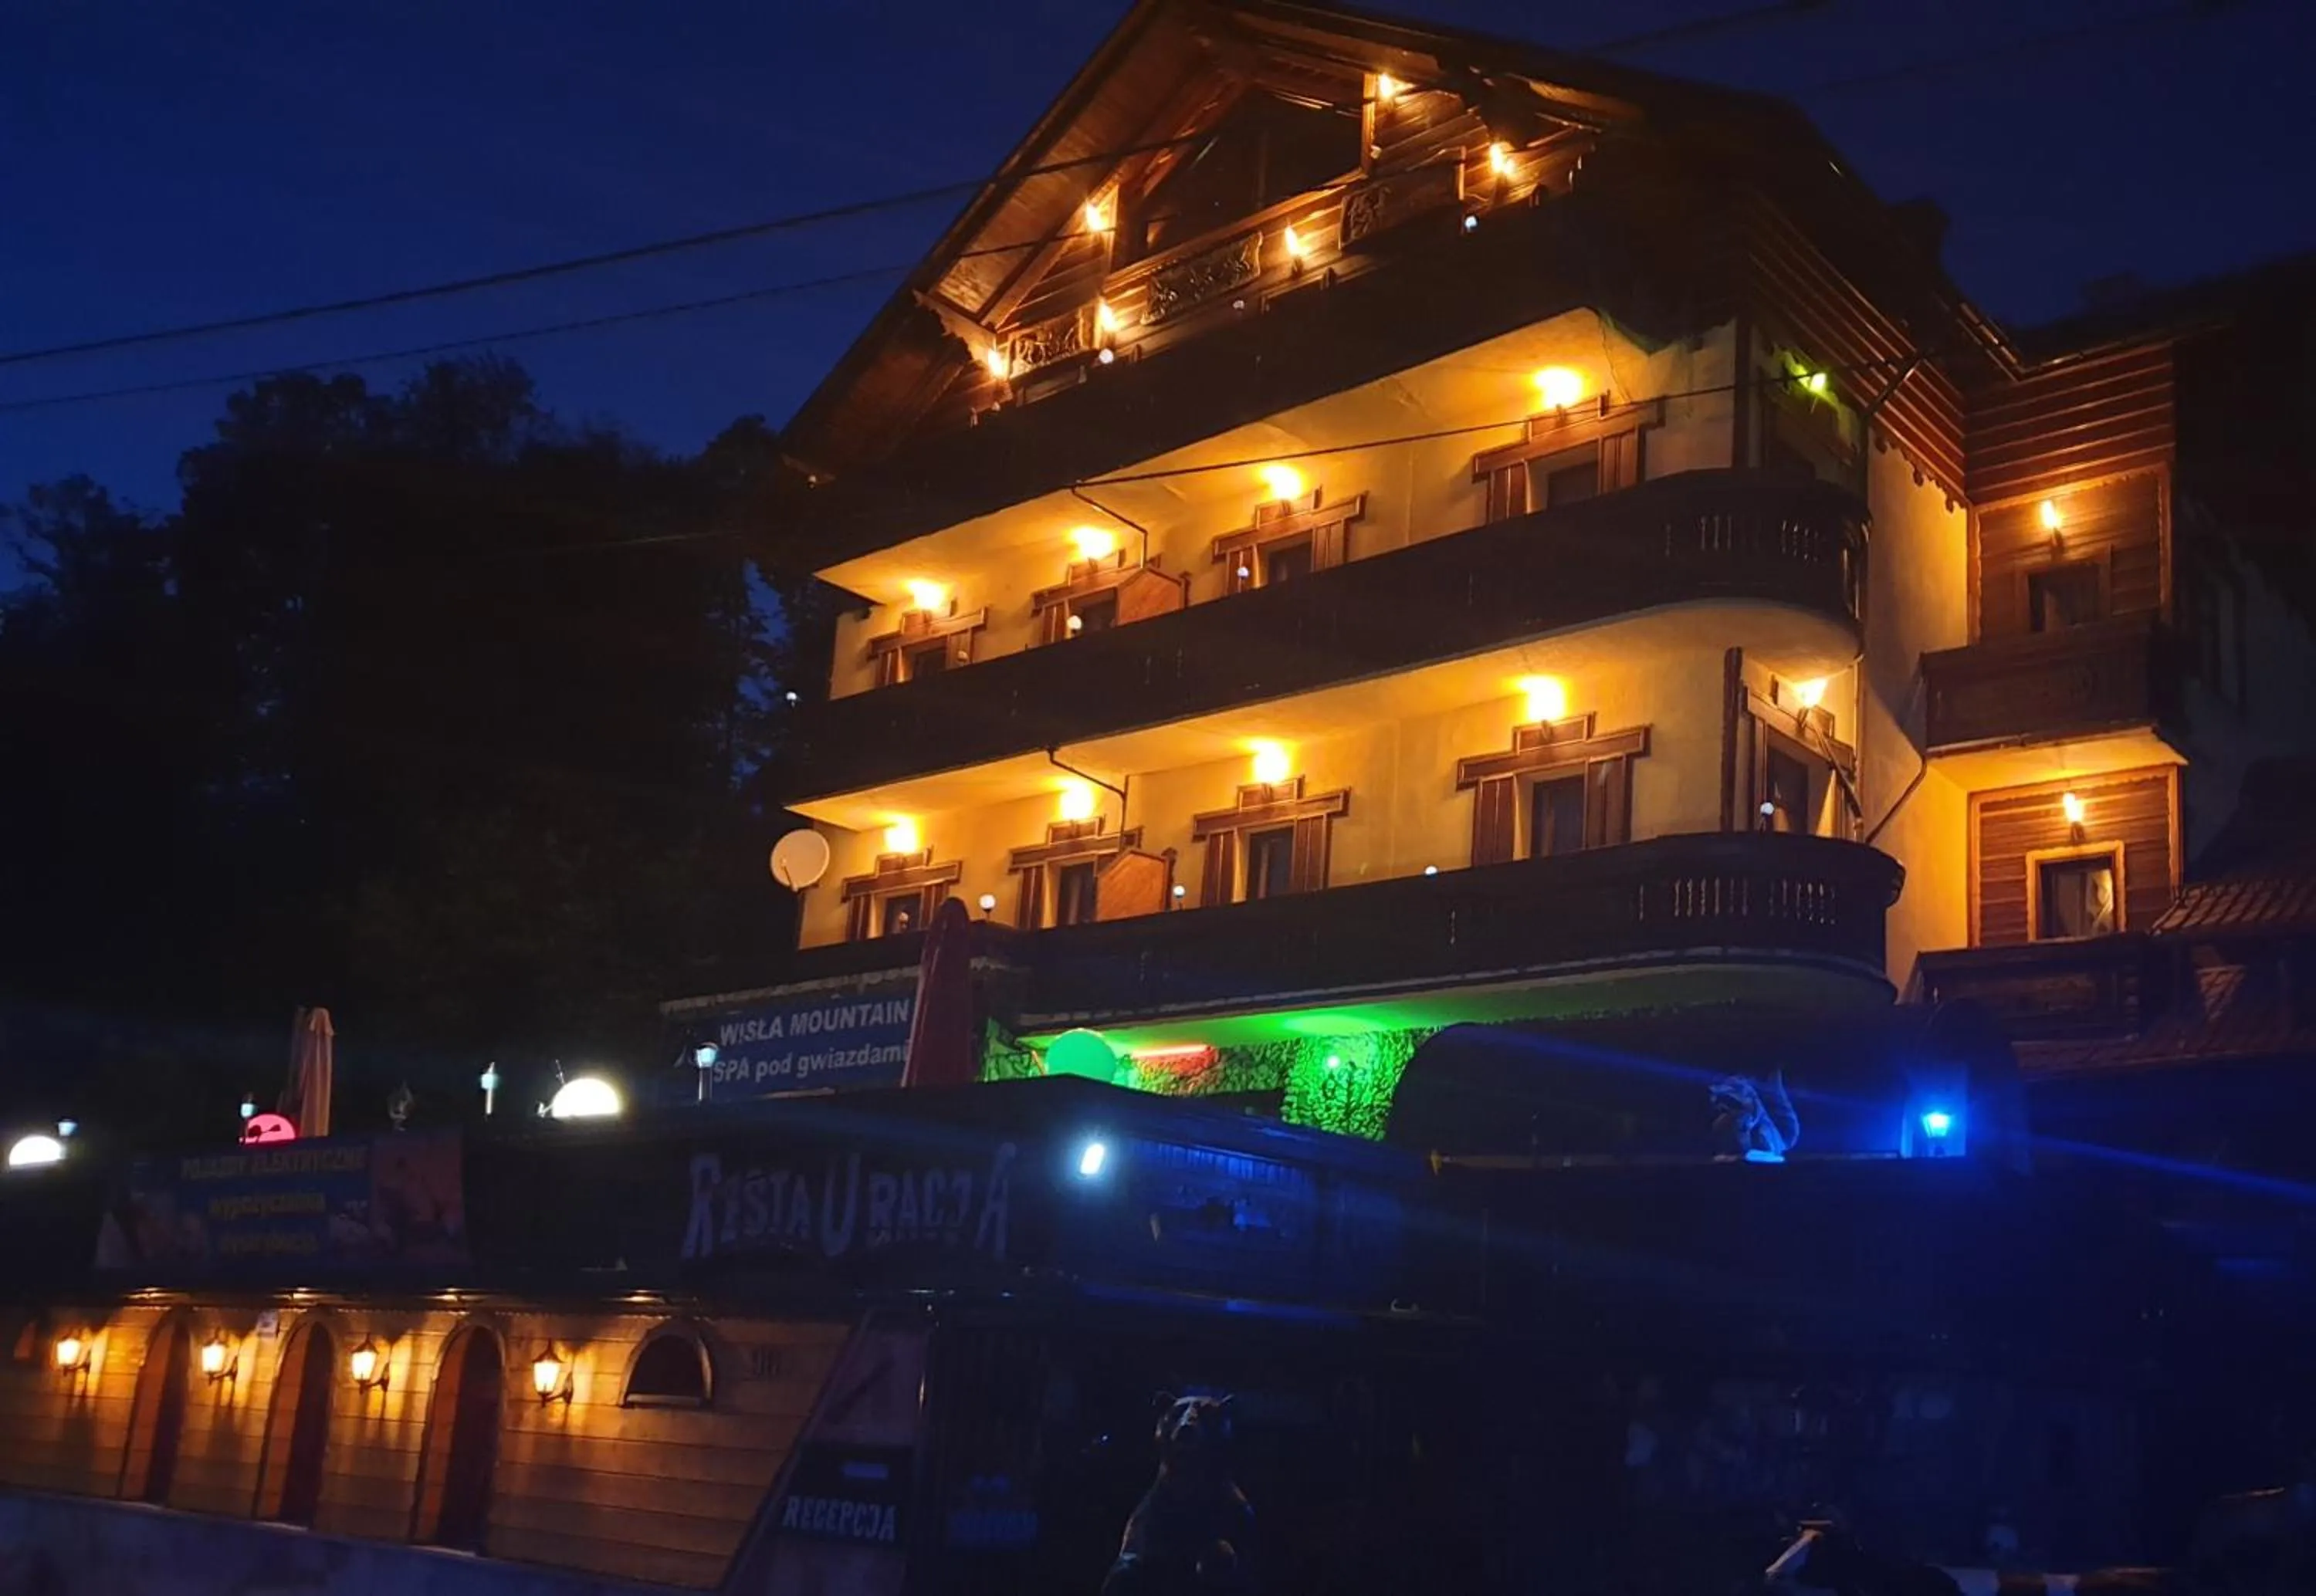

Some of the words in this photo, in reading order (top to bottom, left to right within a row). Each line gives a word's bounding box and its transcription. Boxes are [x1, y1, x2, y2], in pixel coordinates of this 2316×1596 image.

[720, 1016, 784, 1048] WISŁA
[790, 999, 909, 1036] MOUNTAIN
[713, 1058, 750, 1083] SPA
[755, 1053, 791, 1083] pod
[782, 1496, 898, 1543] RECEPCJA
